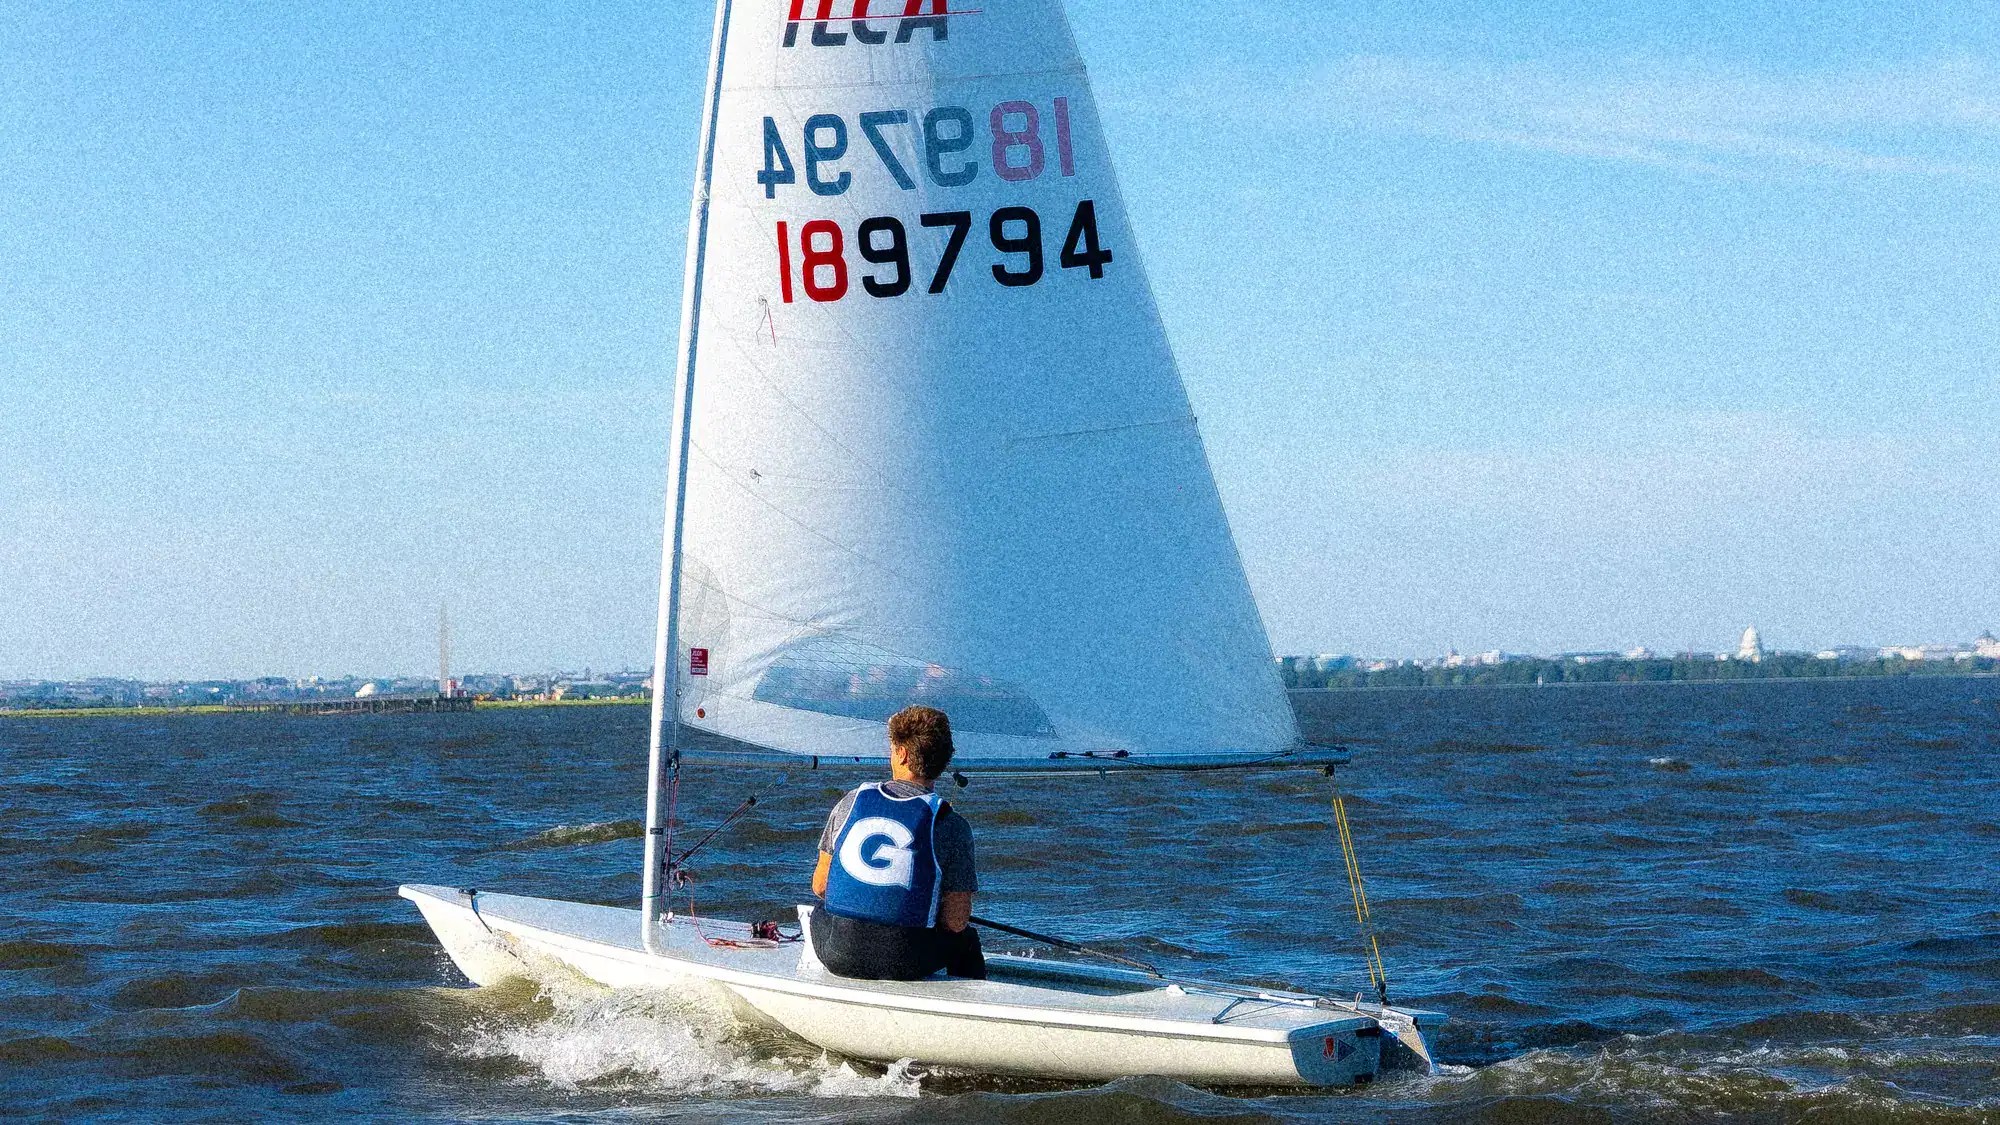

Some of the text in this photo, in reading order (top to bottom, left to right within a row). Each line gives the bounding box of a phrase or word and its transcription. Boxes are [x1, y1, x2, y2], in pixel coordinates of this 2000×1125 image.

[782, 0, 949, 48] ILCA
[776, 199, 1113, 304] 189794
[838, 816, 914, 891] G
